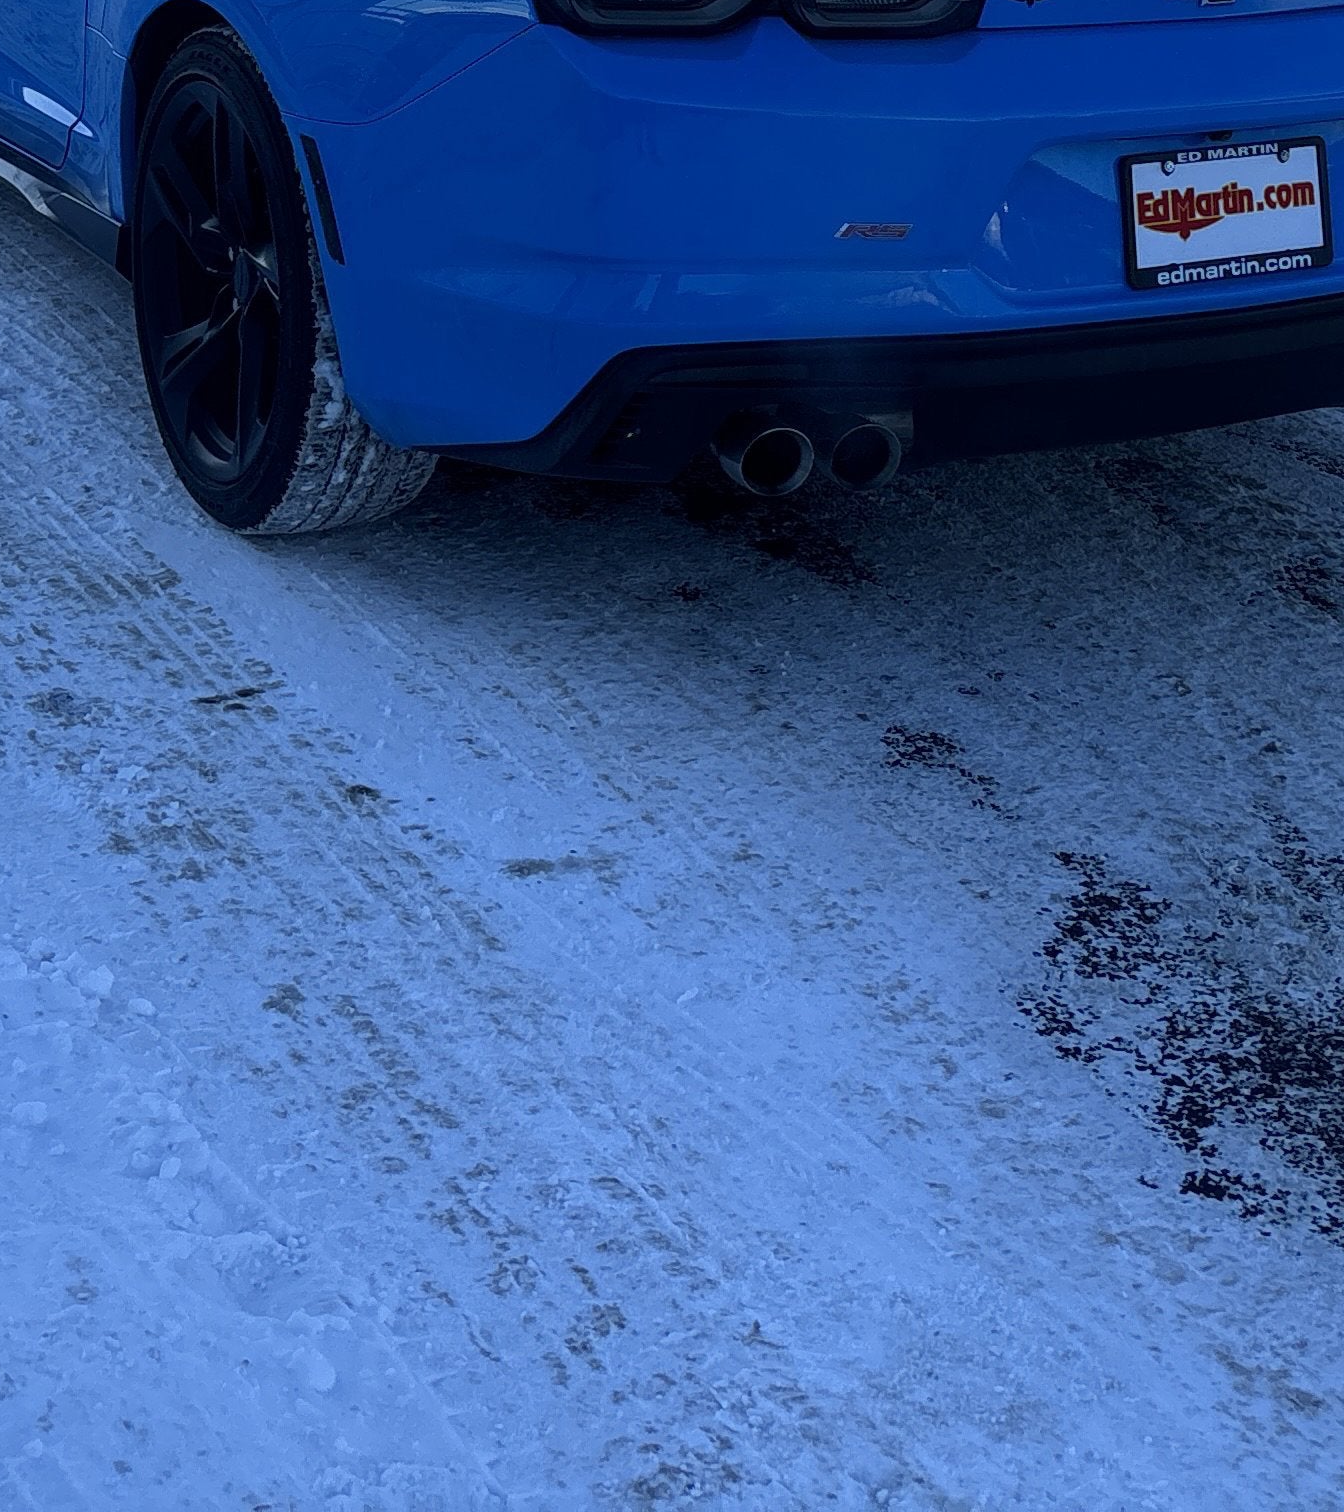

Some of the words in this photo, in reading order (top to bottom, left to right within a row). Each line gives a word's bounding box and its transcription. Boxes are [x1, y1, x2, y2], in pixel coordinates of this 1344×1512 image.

[1176, 151, 1202, 164] ED
[1207, 143, 1279, 160] MARTIN
[1137, 181, 1316, 226] EdMartin.com
[1157, 254, 1312, 286] edmartin.com
